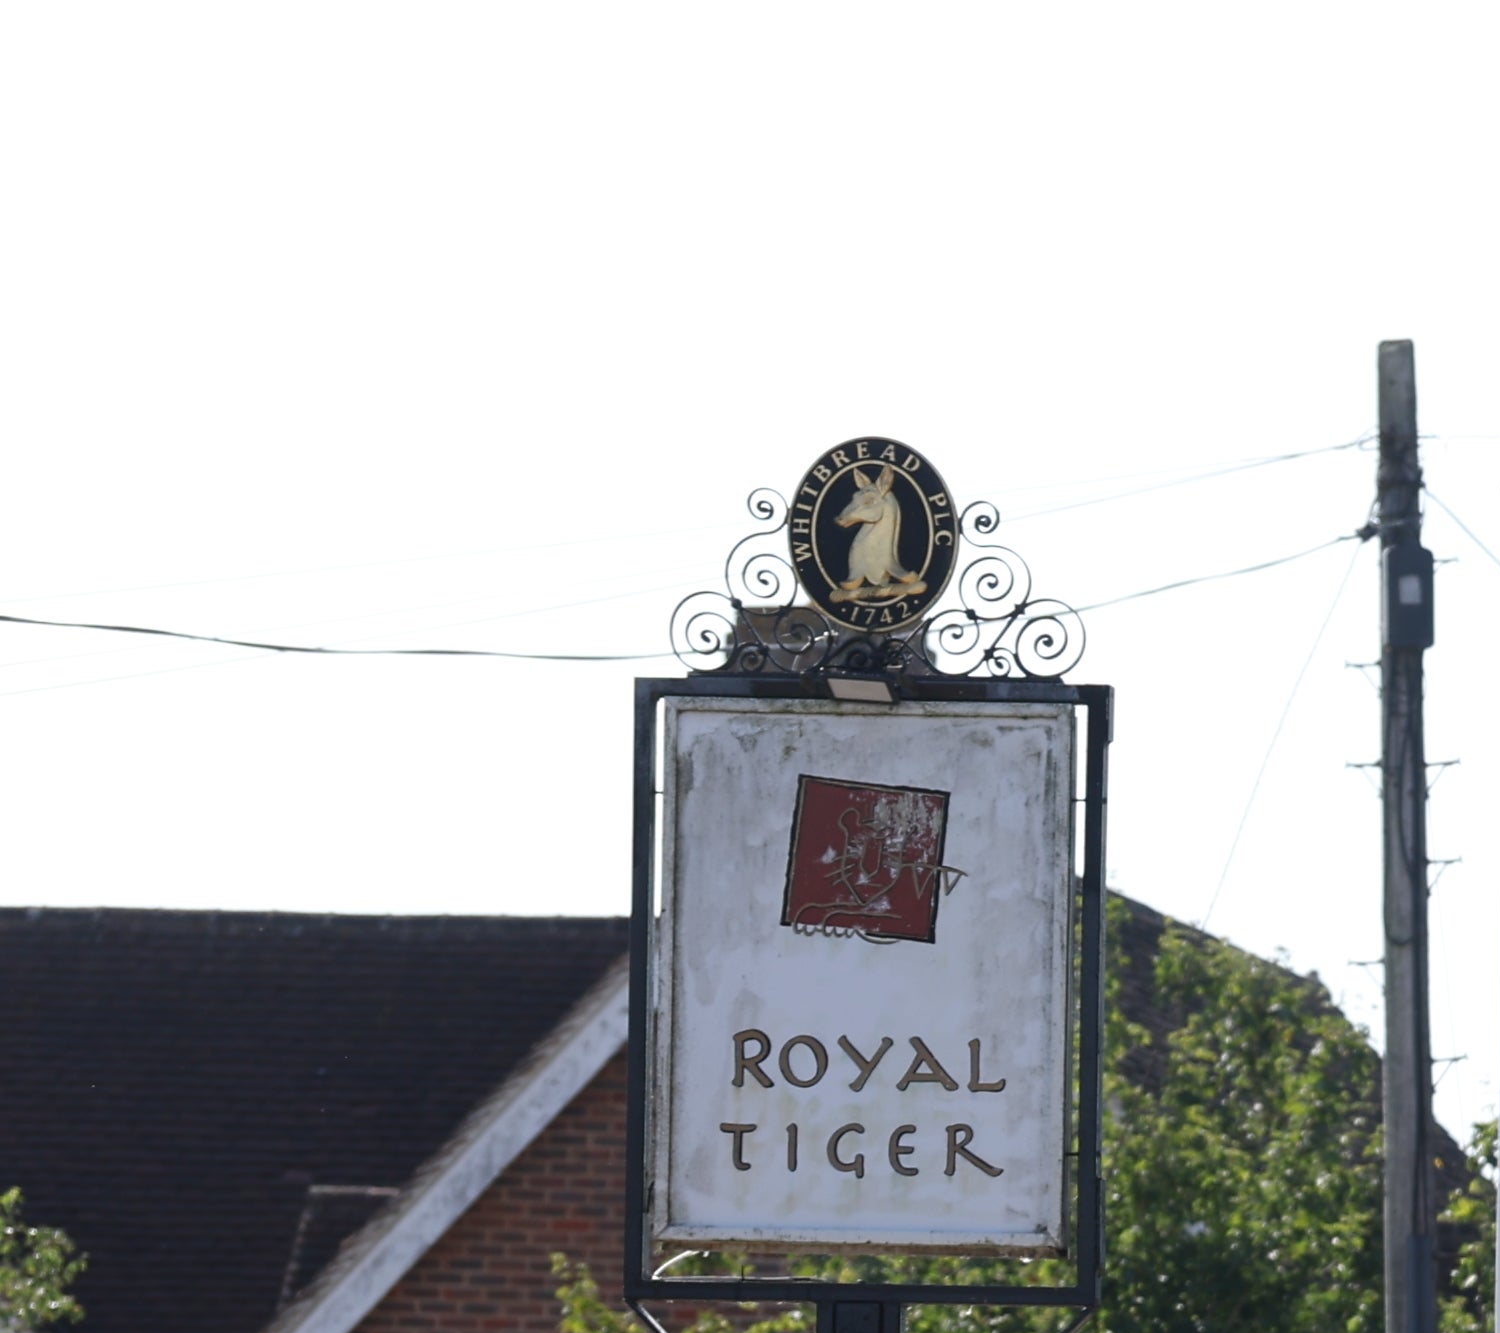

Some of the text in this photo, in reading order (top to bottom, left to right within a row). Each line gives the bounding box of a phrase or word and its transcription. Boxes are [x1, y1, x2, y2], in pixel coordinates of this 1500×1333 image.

[792, 441, 953, 563] WHITBREAD PLC
[849, 602, 913, 625] 1742
[731, 1028, 1007, 1093] ROYAL
[719, 1122, 1005, 1179] TIGER
